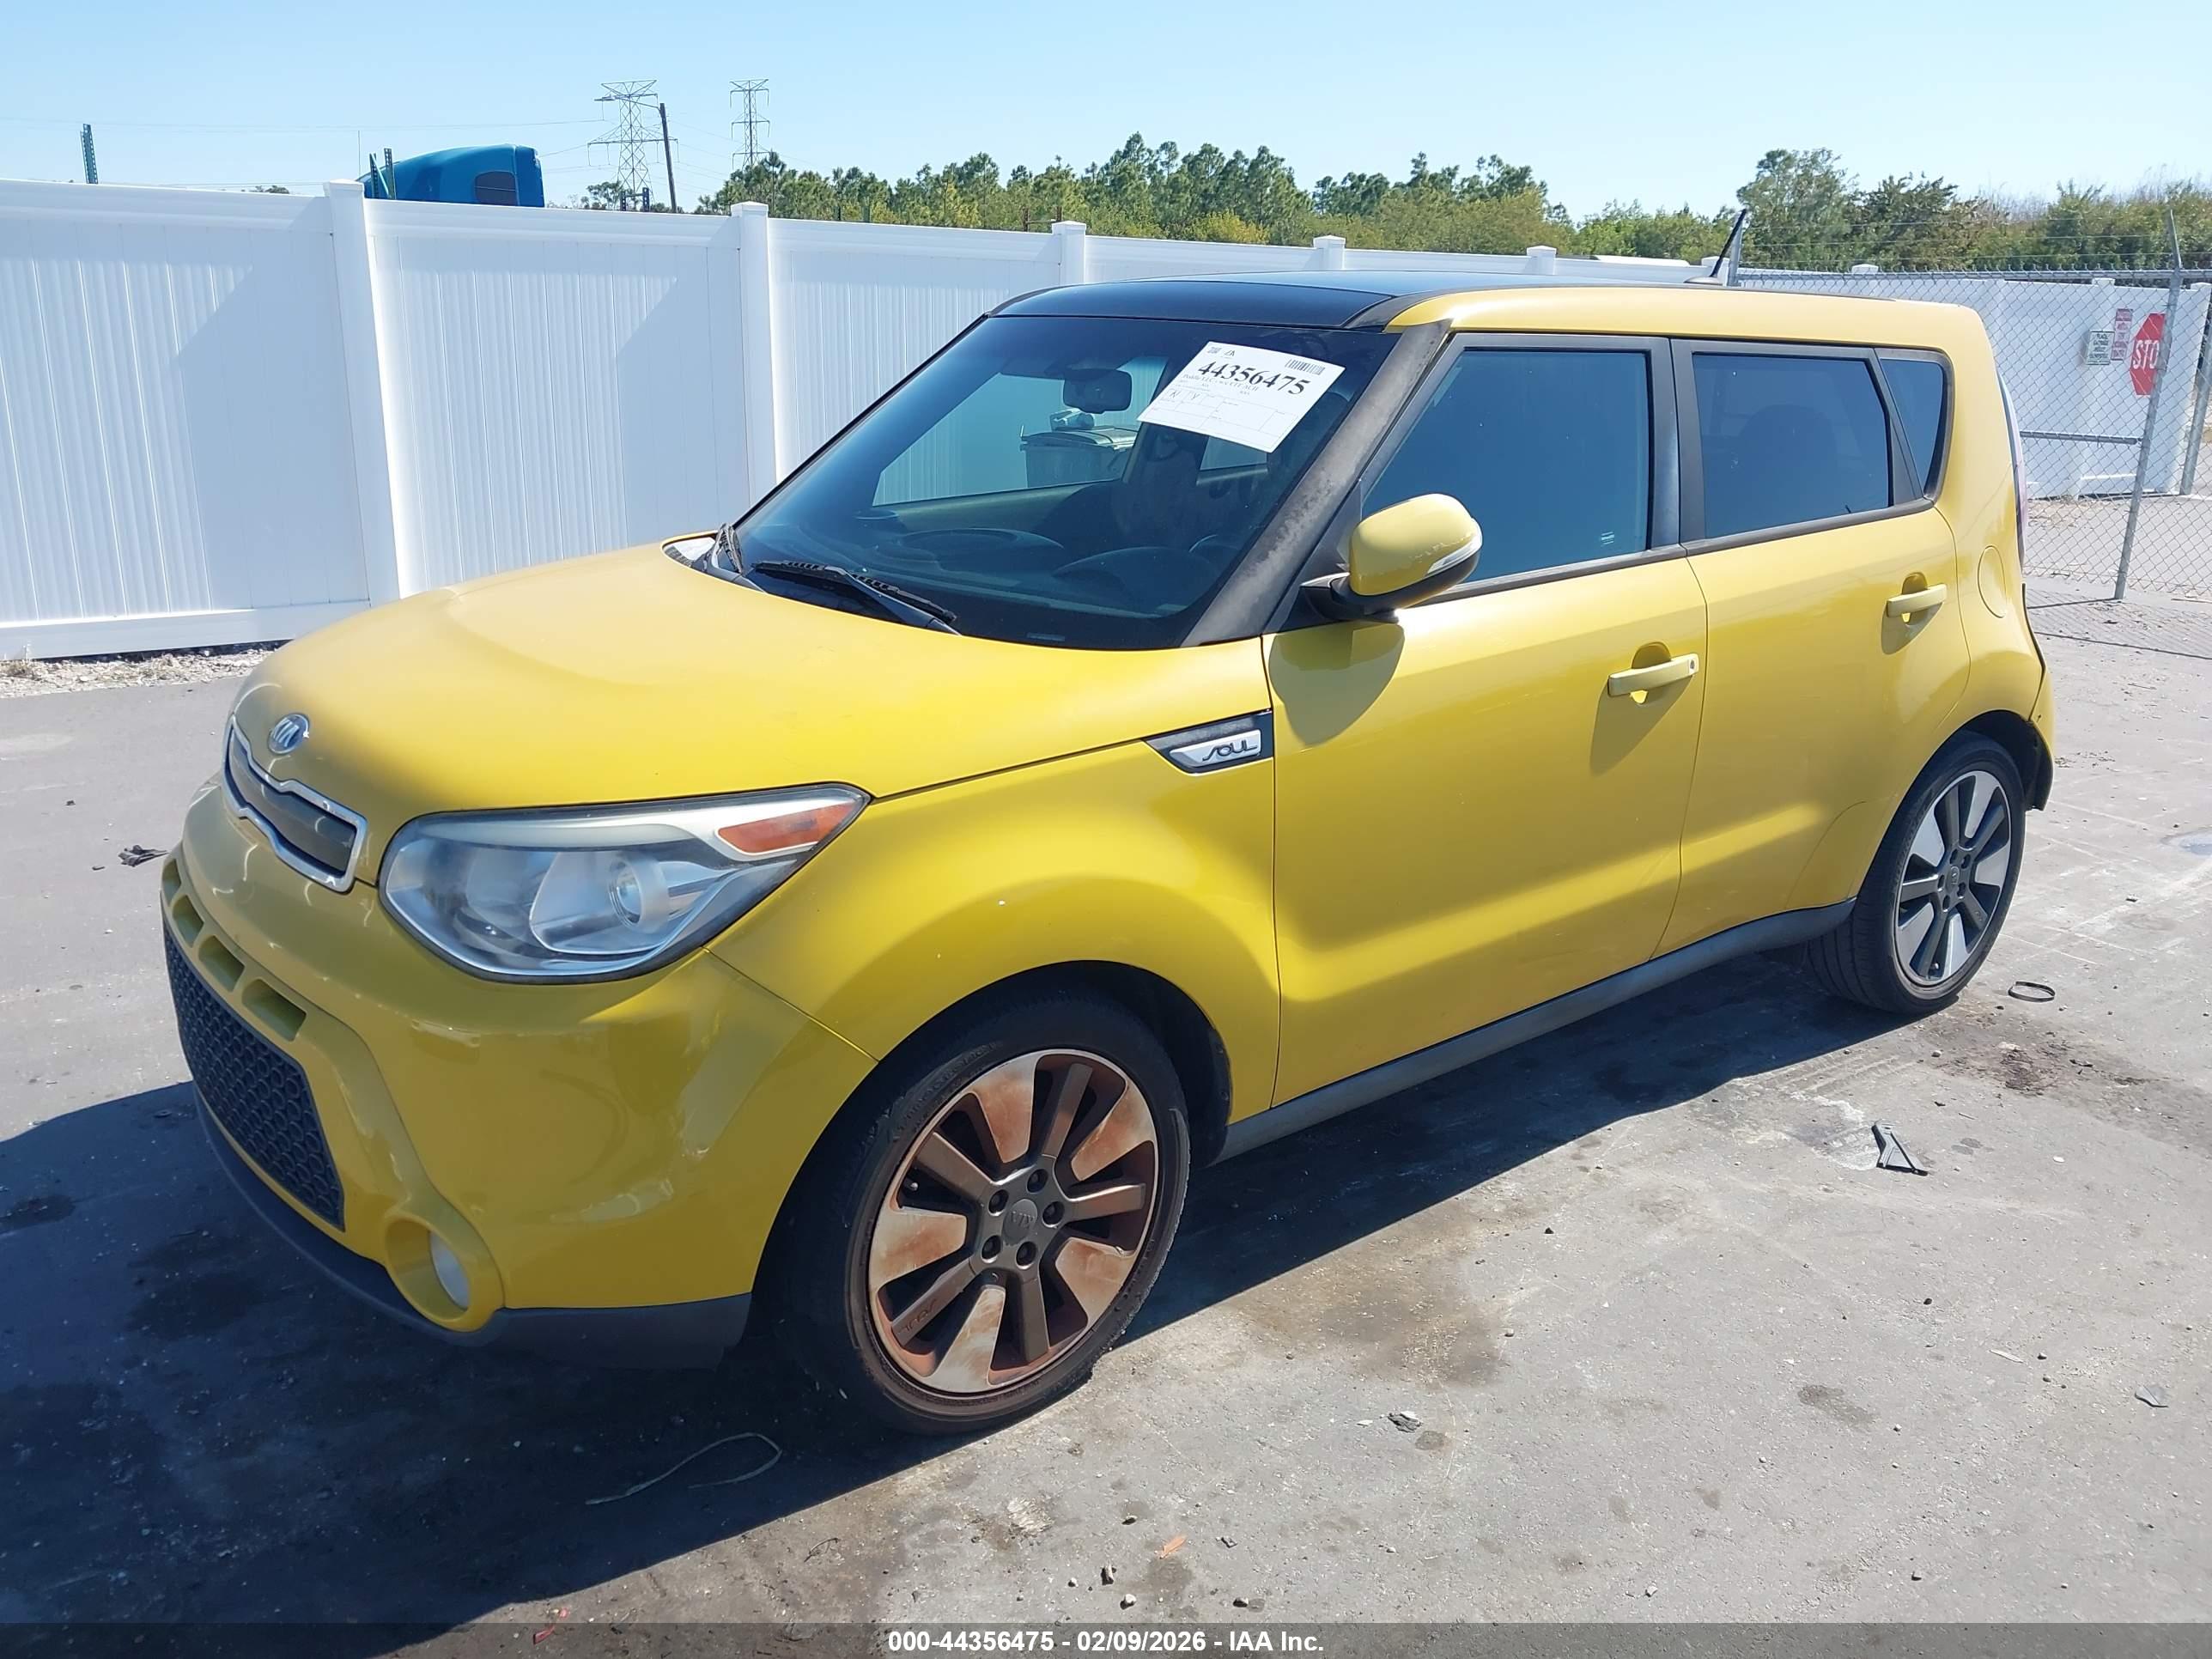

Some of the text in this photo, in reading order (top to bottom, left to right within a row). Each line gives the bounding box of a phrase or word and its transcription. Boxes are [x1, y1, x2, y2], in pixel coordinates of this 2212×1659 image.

[2132, 339, 2160, 370] STO
[1198, 361, 1310, 395] 44356475
[1202, 739, 1258, 762] SOUL
